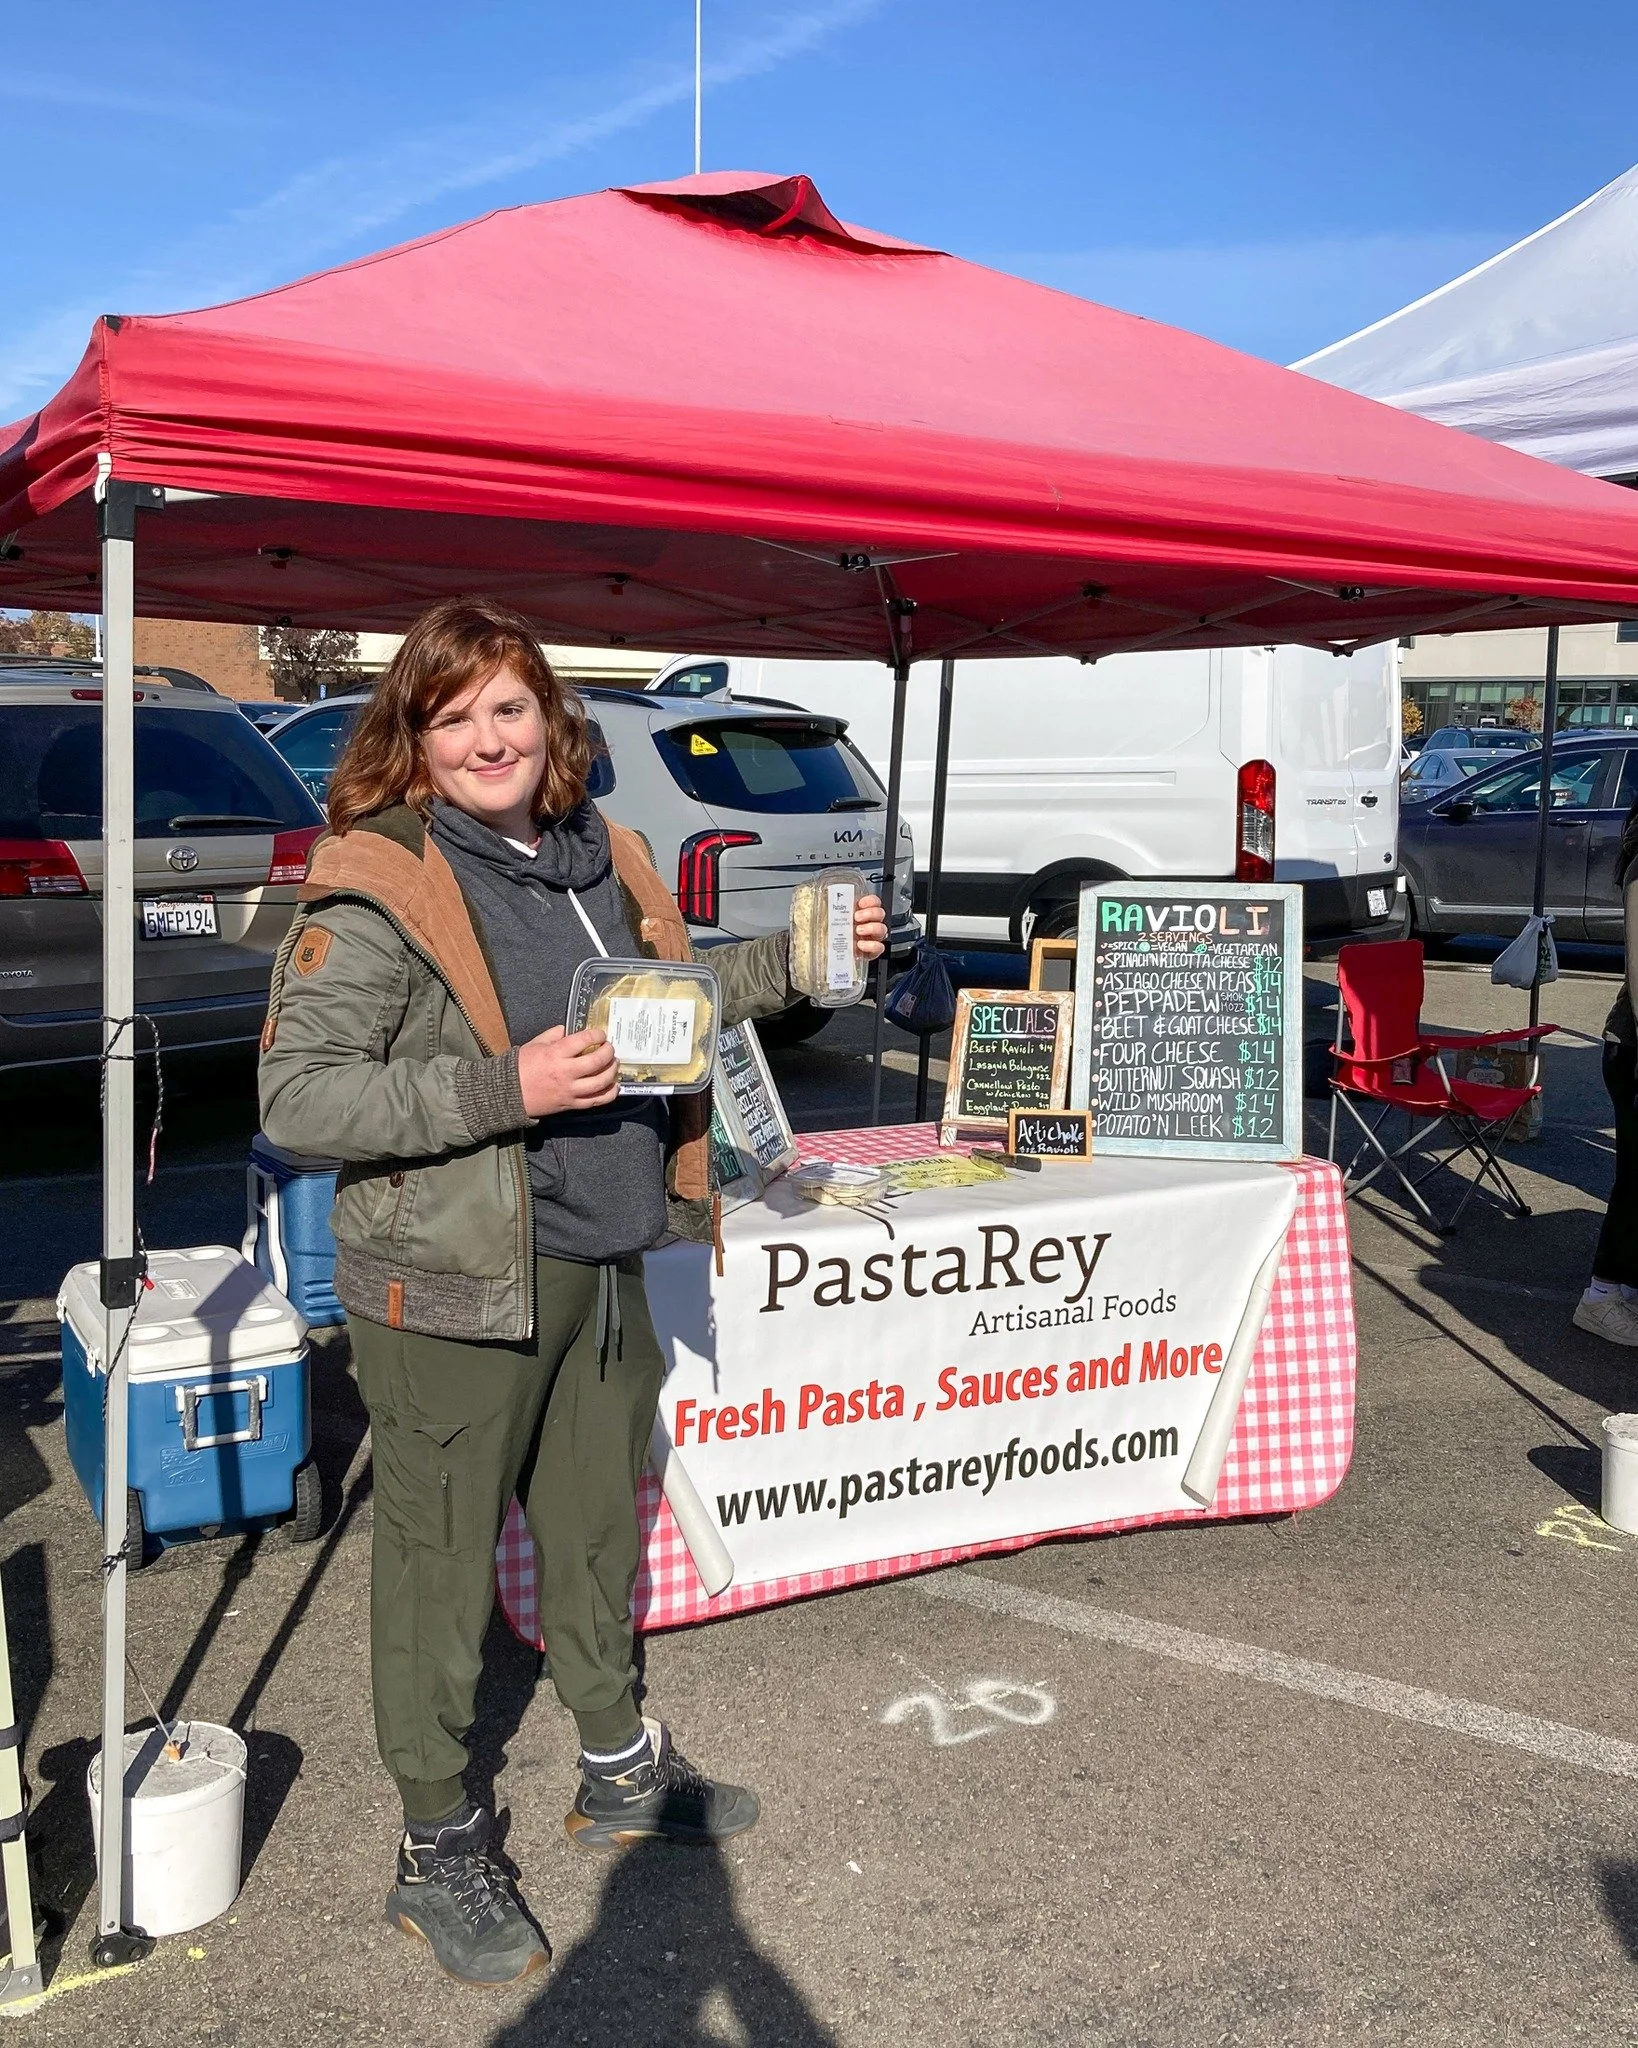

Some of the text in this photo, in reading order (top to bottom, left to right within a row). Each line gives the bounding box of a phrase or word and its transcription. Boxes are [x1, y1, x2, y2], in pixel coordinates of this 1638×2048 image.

[796, 850, 882, 860] TELLURID
[147, 909, 213, 934] 5MFP194
[1101, 901, 1269, 936] RAVIOLI
[1138, 932, 1213, 944] 2 SERVINGS
[0, 969, 34, 978] OYOTA
[1159, 952, 1211, 969] RICOTTA
[1211, 955, 1251, 969] CHEESE
[1253, 954, 1283, 974] $12
[1102, 971, 1160, 991] ASIAGO
[1219, 970, 1256, 994] PEAS
[1253, 971, 1282, 996] $14
[1104, 989, 1220, 1015] PEPPADEW
[1245, 993, 1281, 1017] $14
[971, 1005, 1056, 1033] SPECIALS
[1100, 1014, 1282, 1040] BEET & GOAT CHEESE $14
[1099, 1039, 1275, 1066] FOUR CHEESE $14
[1098, 1065, 1280, 1092] BUTTERNUT SQUASH $12
[966, 1099, 1009, 1115] Eggplant
[1097, 1091, 1275, 1115] WILD MUSHROOM $14
[1175, 1114, 1224, 1138] LEEK
[1232, 1115, 1278, 1139] $12
[759, 1224, 1112, 1313] PastaRey
[968, 1288, 1177, 1337] Artisanal Foods
[674, 1387, 786, 1447] Fresh
[798, 1379, 905, 1430] Pasta
[935, 1364, 1059, 1411] Sauces
[1066, 1342, 1132, 1393] and
[1138, 1339, 1223, 1383] More
[716, 1425, 1179, 1528] www.pastareyfoods.com
